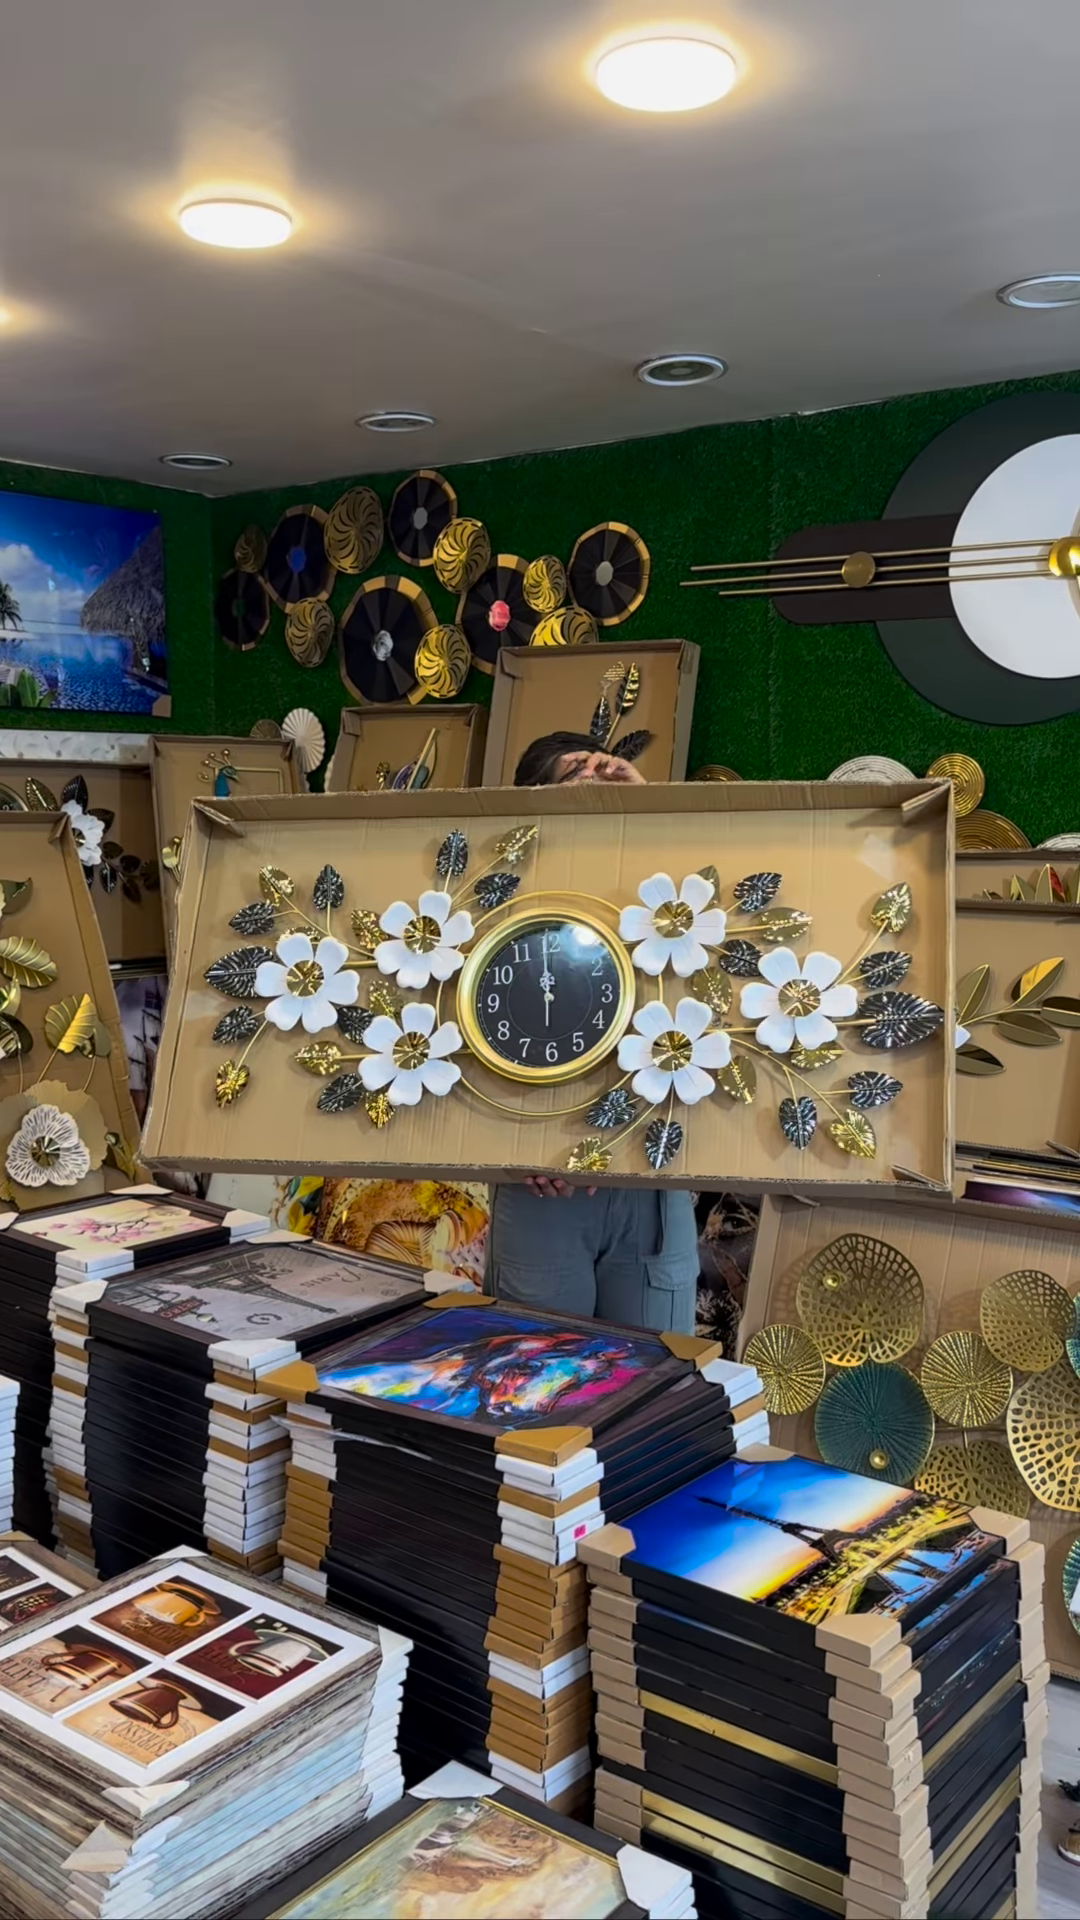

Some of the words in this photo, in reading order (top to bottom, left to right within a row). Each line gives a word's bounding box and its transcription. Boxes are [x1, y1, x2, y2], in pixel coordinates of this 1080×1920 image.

[512, 943, 533, 963] 11
[492, 965, 514, 985] 10
[591, 958, 605, 976] 2
[487, 993, 500, 1013] 9
[601, 983, 613, 1003] 3
[592, 1009, 605, 1029] 4
[497, 1020, 510, 1040] 8
[519, 1038, 532, 1058] 7
[545, 1042, 558, 1062] 6
[572, 1032, 584, 1052] 5
